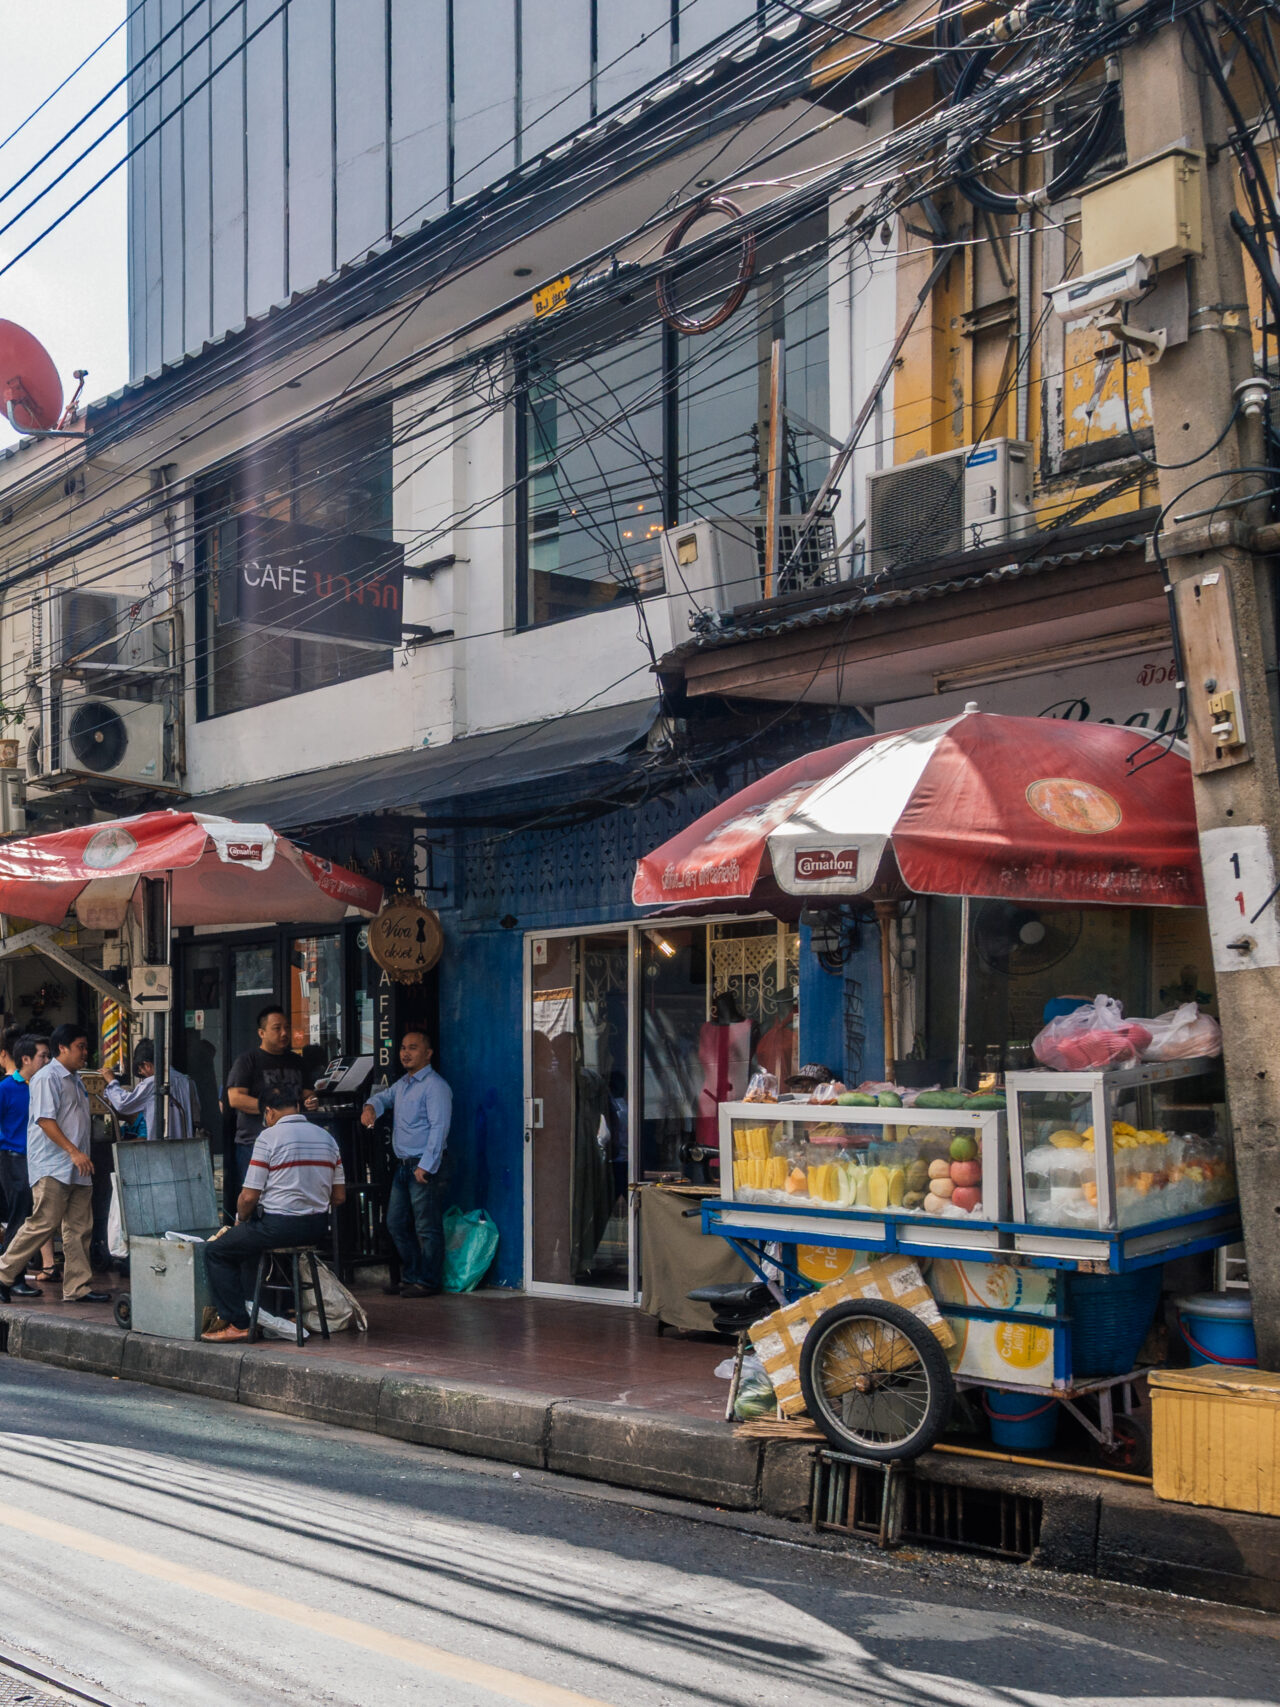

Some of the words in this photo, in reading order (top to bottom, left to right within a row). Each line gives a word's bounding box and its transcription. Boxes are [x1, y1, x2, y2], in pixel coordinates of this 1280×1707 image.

[244, 560, 307, 594] CAFÉ
[797, 857, 853, 875] Carnation
[1229, 852, 1240, 879] 1
[1234, 891, 1246, 916] 1
[381, 916, 412, 938] Viva
[384, 943, 412, 959] closet
